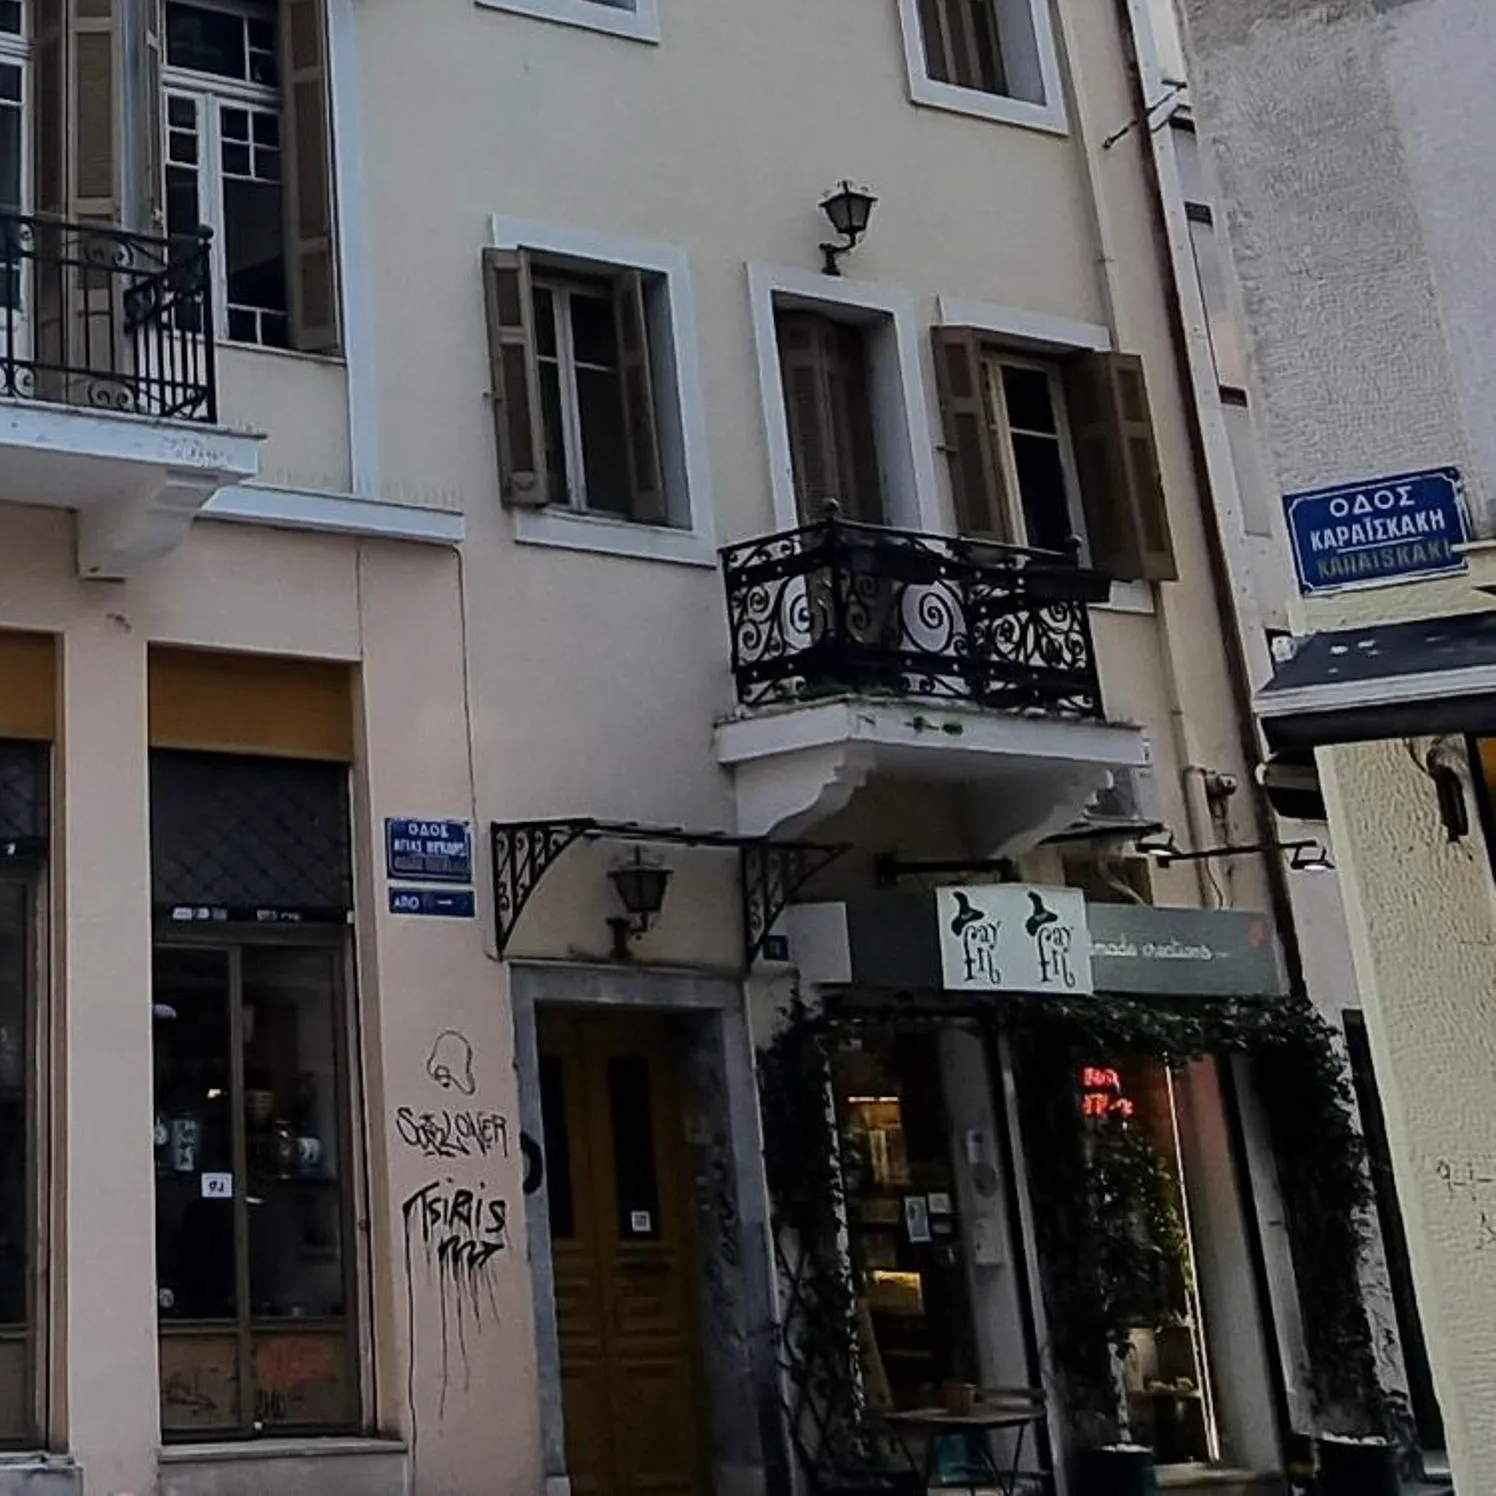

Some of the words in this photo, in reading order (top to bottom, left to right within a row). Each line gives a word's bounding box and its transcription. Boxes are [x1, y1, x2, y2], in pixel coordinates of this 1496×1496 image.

[1329, 485, 1415, 517] ΟΔΟΣ
[1310, 508, 1446, 552] ΚΑΡΑΪΣΚΑΚΗ
[408, 822, 450, 839] ΟΔΟΣ
